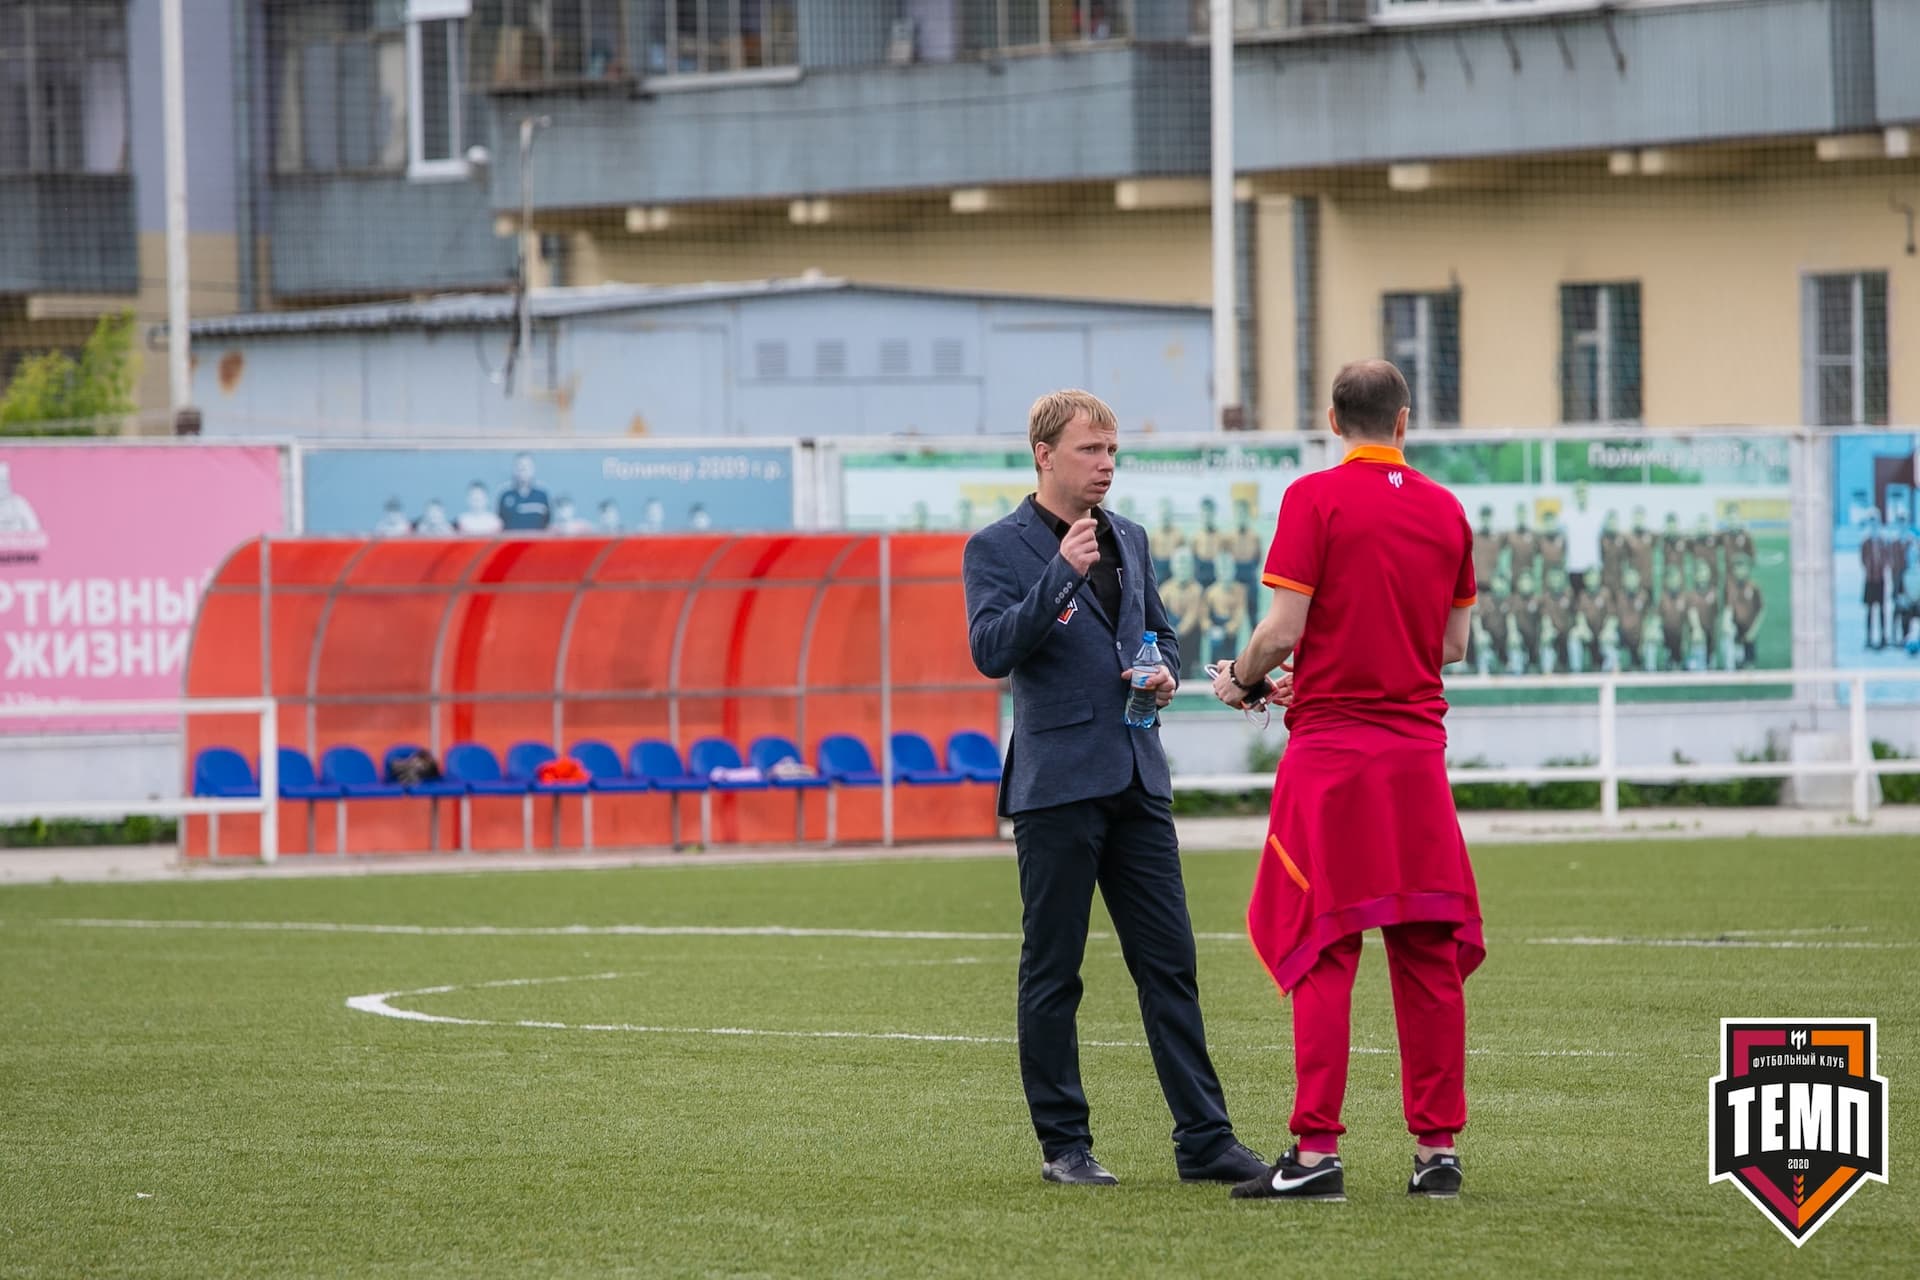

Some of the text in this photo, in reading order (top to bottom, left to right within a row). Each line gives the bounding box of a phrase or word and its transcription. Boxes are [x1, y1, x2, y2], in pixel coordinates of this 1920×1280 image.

[603, 456, 694, 484] Полимер
[1588, 442, 1682, 472] Полимер
[0, 574, 206, 626] РТИВНЫ
[5, 629, 190, 679] ЖИЗНИ
